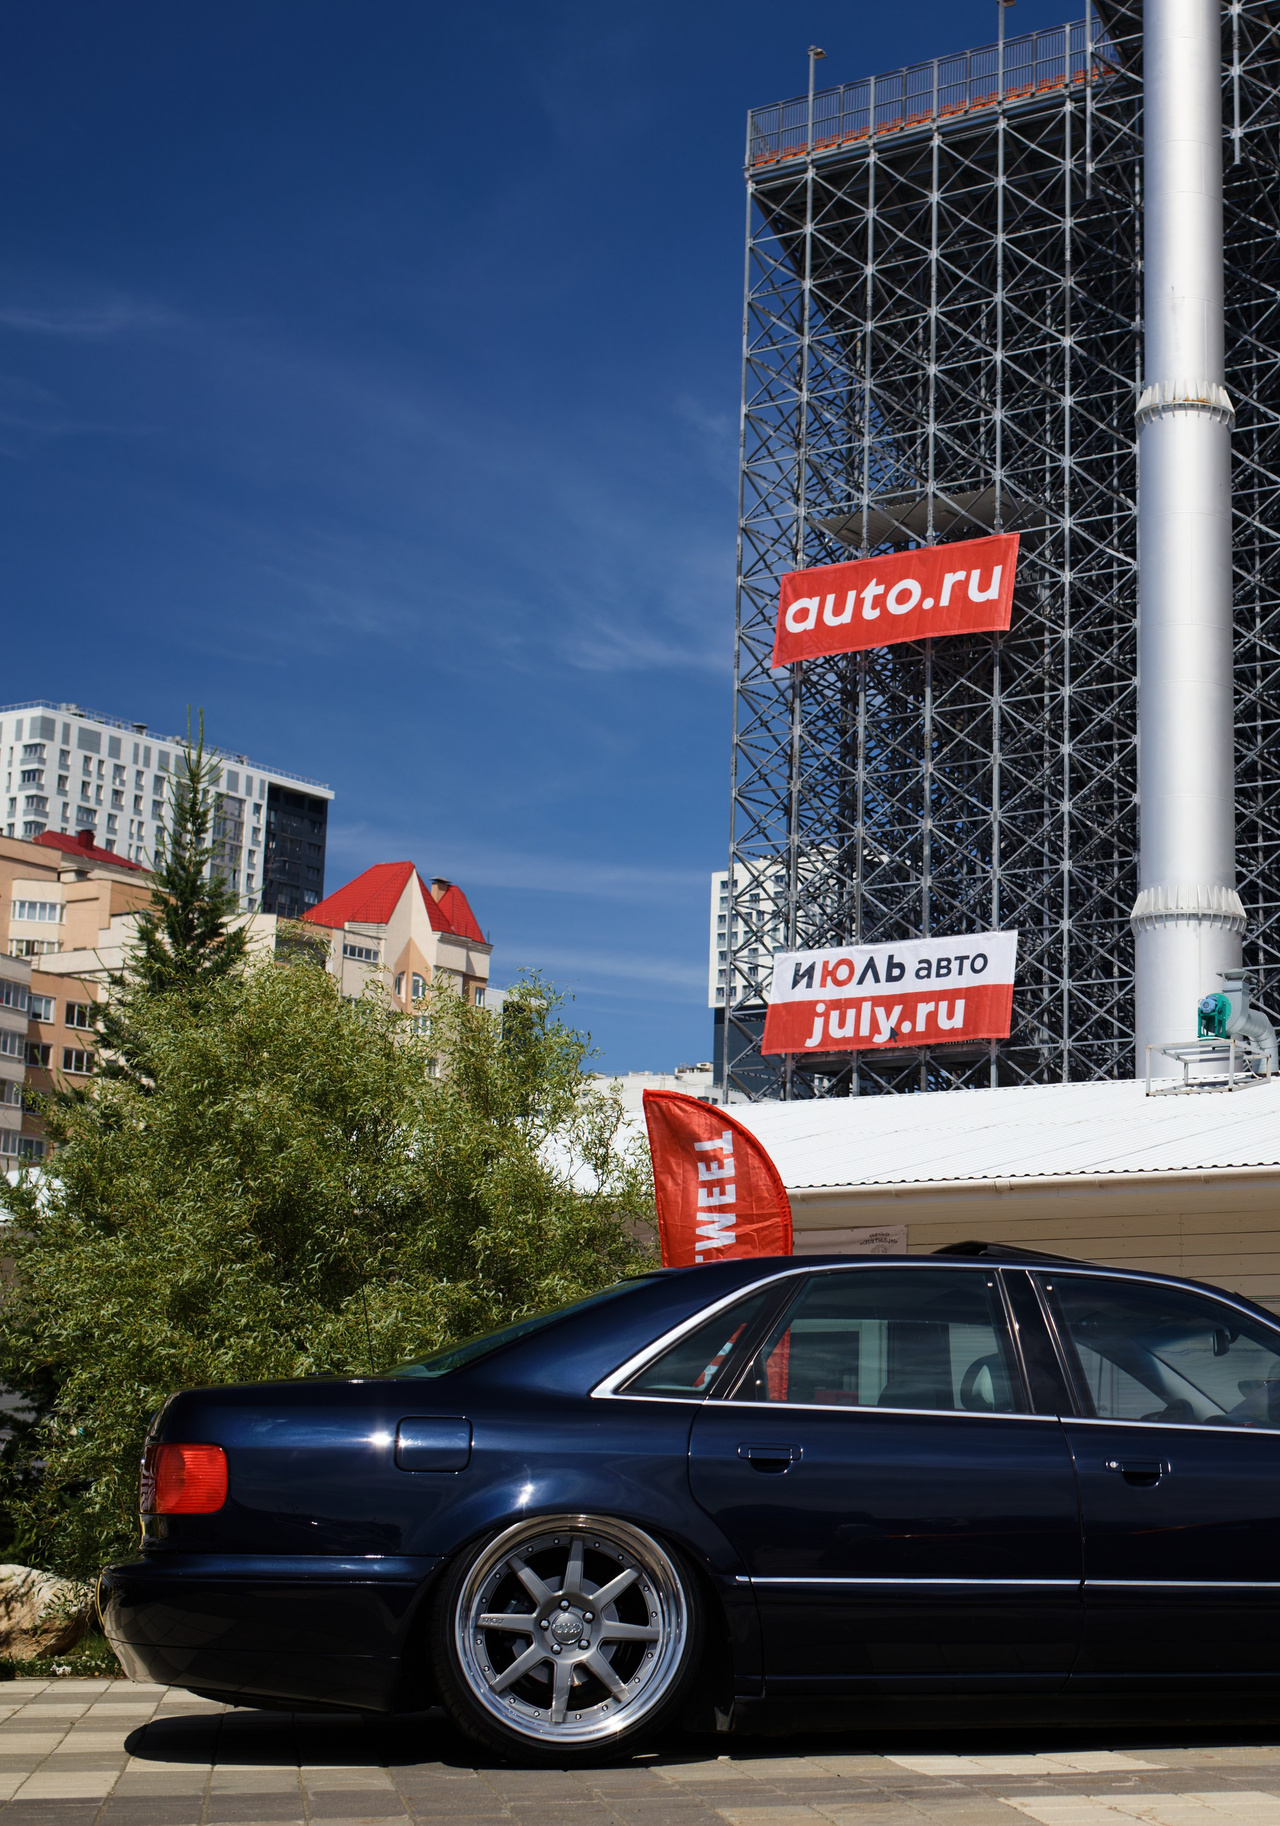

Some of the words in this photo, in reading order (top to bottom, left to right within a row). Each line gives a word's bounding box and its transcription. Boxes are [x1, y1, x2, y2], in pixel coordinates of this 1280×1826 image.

[785, 565, 1003, 634] auto.ru
[791, 954, 906, 990] ИЮЛЬ
[804, 999, 966, 1047] july.ru
